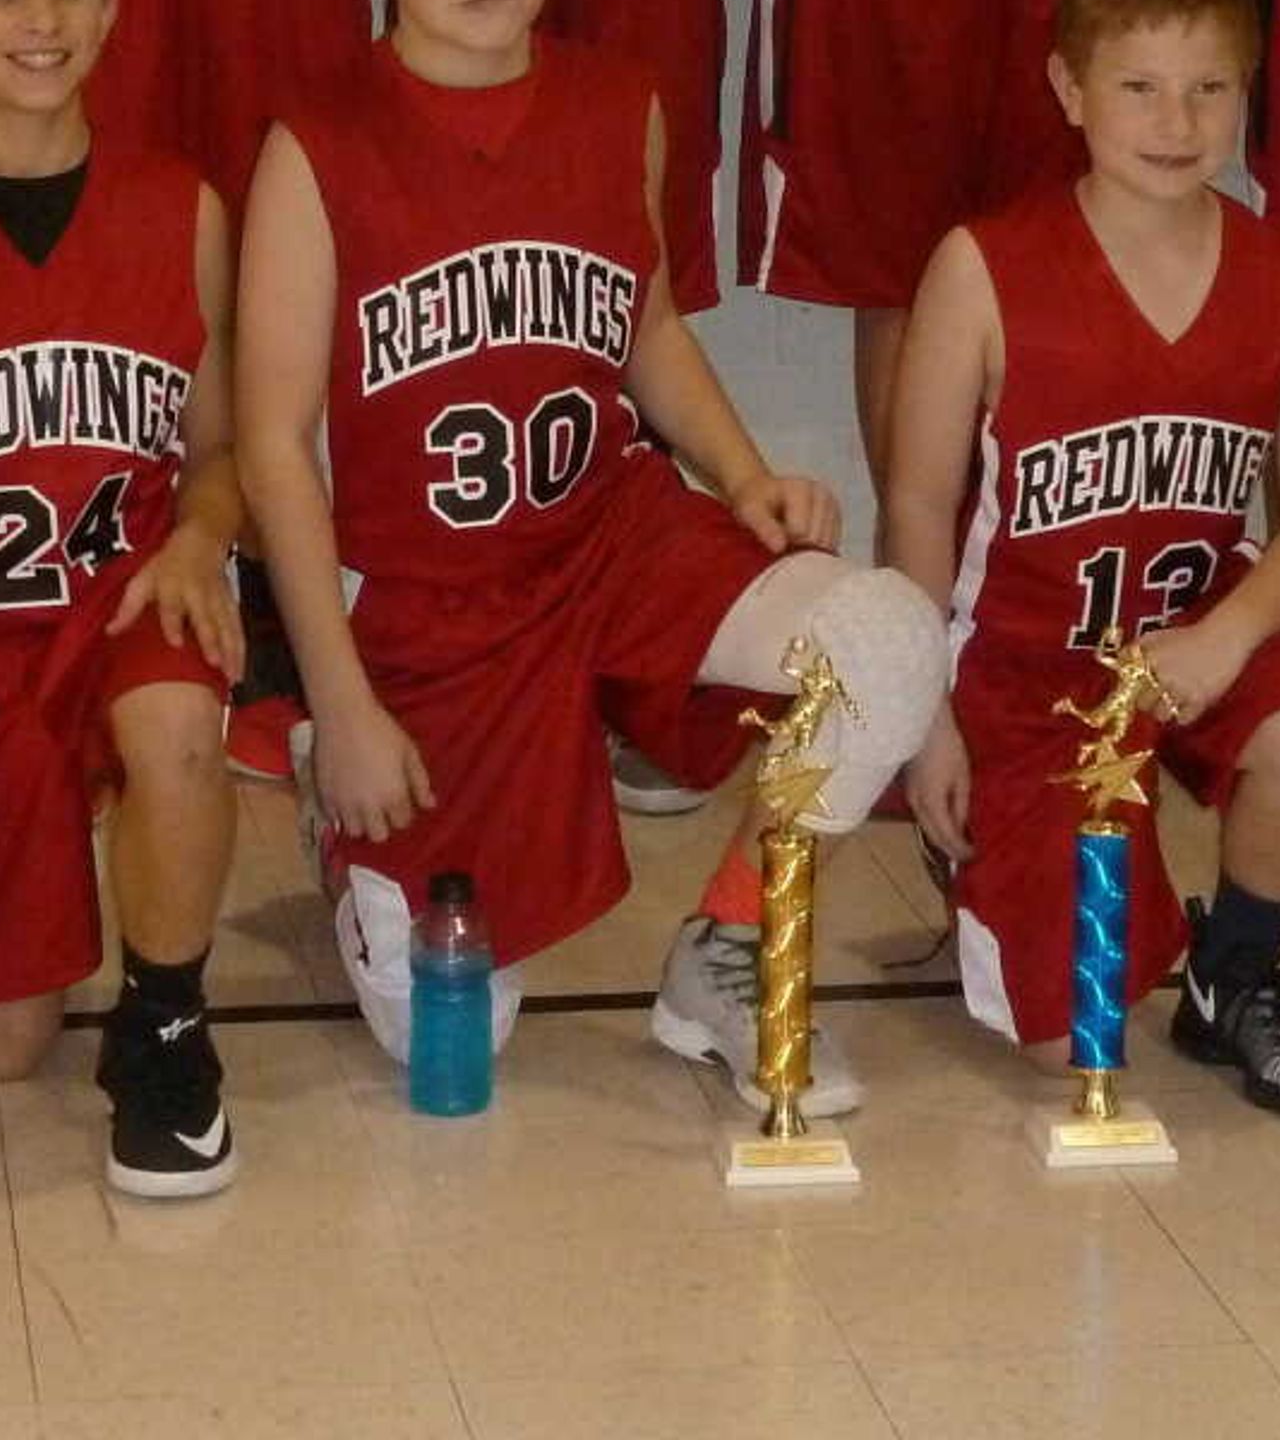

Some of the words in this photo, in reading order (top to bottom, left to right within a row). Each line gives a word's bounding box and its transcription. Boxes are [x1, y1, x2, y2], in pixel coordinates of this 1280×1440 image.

[359, 239, 637, 397] REDWINGS
[426, 386, 597, 528] 30
[1010, 415, 1275, 538] REDWING
[1066, 540, 1218, 650] 13
